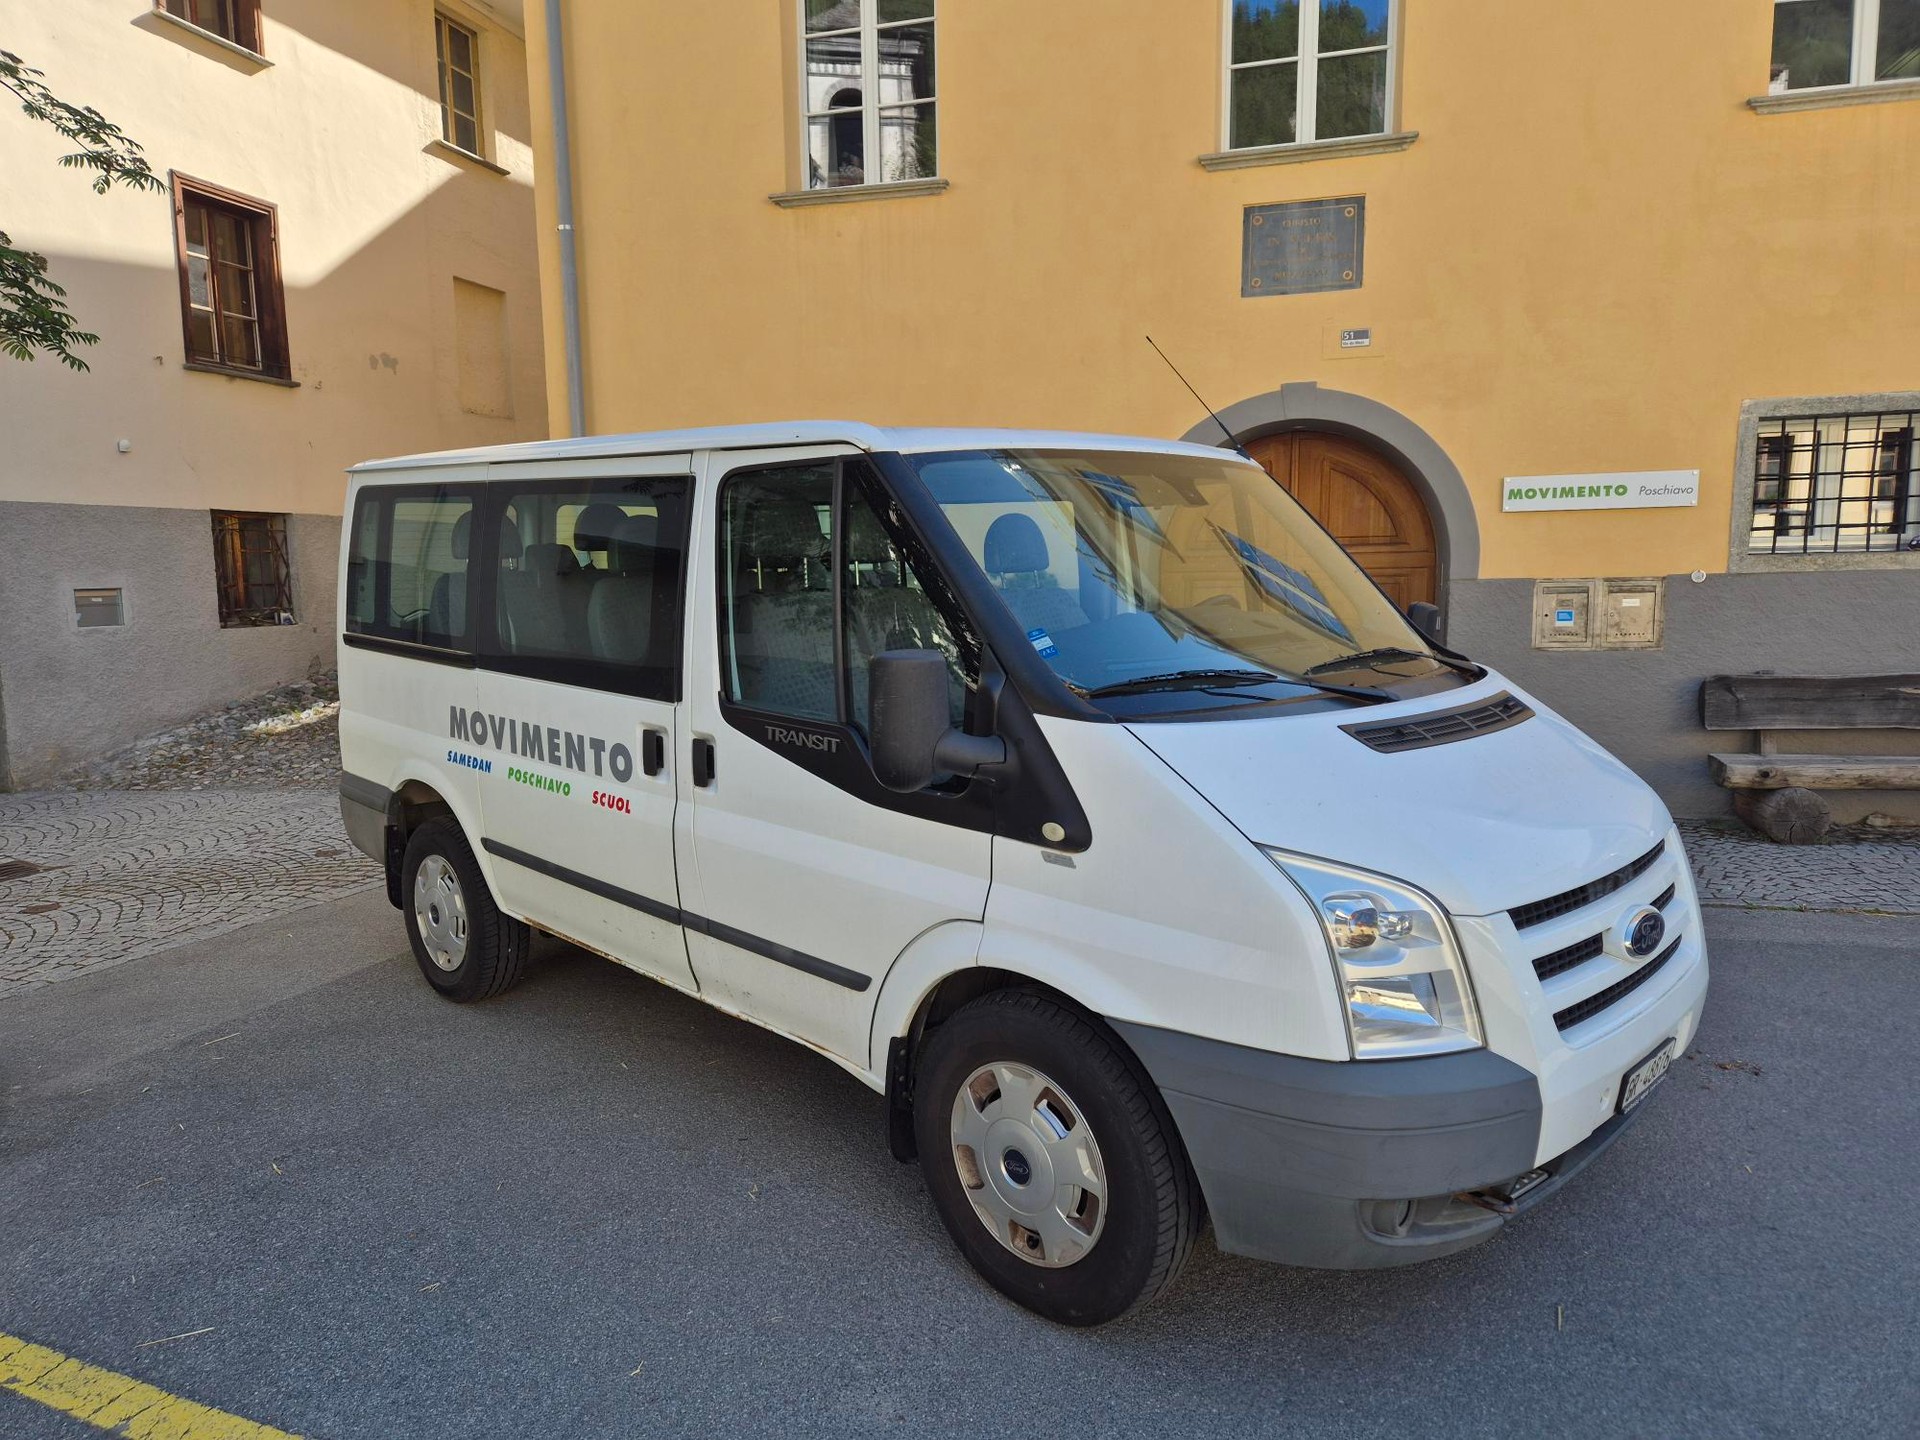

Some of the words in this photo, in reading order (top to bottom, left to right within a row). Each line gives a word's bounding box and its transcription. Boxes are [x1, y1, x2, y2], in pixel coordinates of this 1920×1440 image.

[1344, 331, 1354, 340] 51
[1507, 484, 1629, 500] MOVIMENTO
[1638, 484, 1694, 497] Poschiavo
[449, 705, 634, 783] MOVIMENTO
[764, 725, 841, 753] TRANSIT
[446, 750, 492, 774] SAMEDAN
[507, 766, 572, 797] POSCHIAVO
[591, 790, 632, 815] SCUOL
[1640, 919, 1662, 949] Ford
